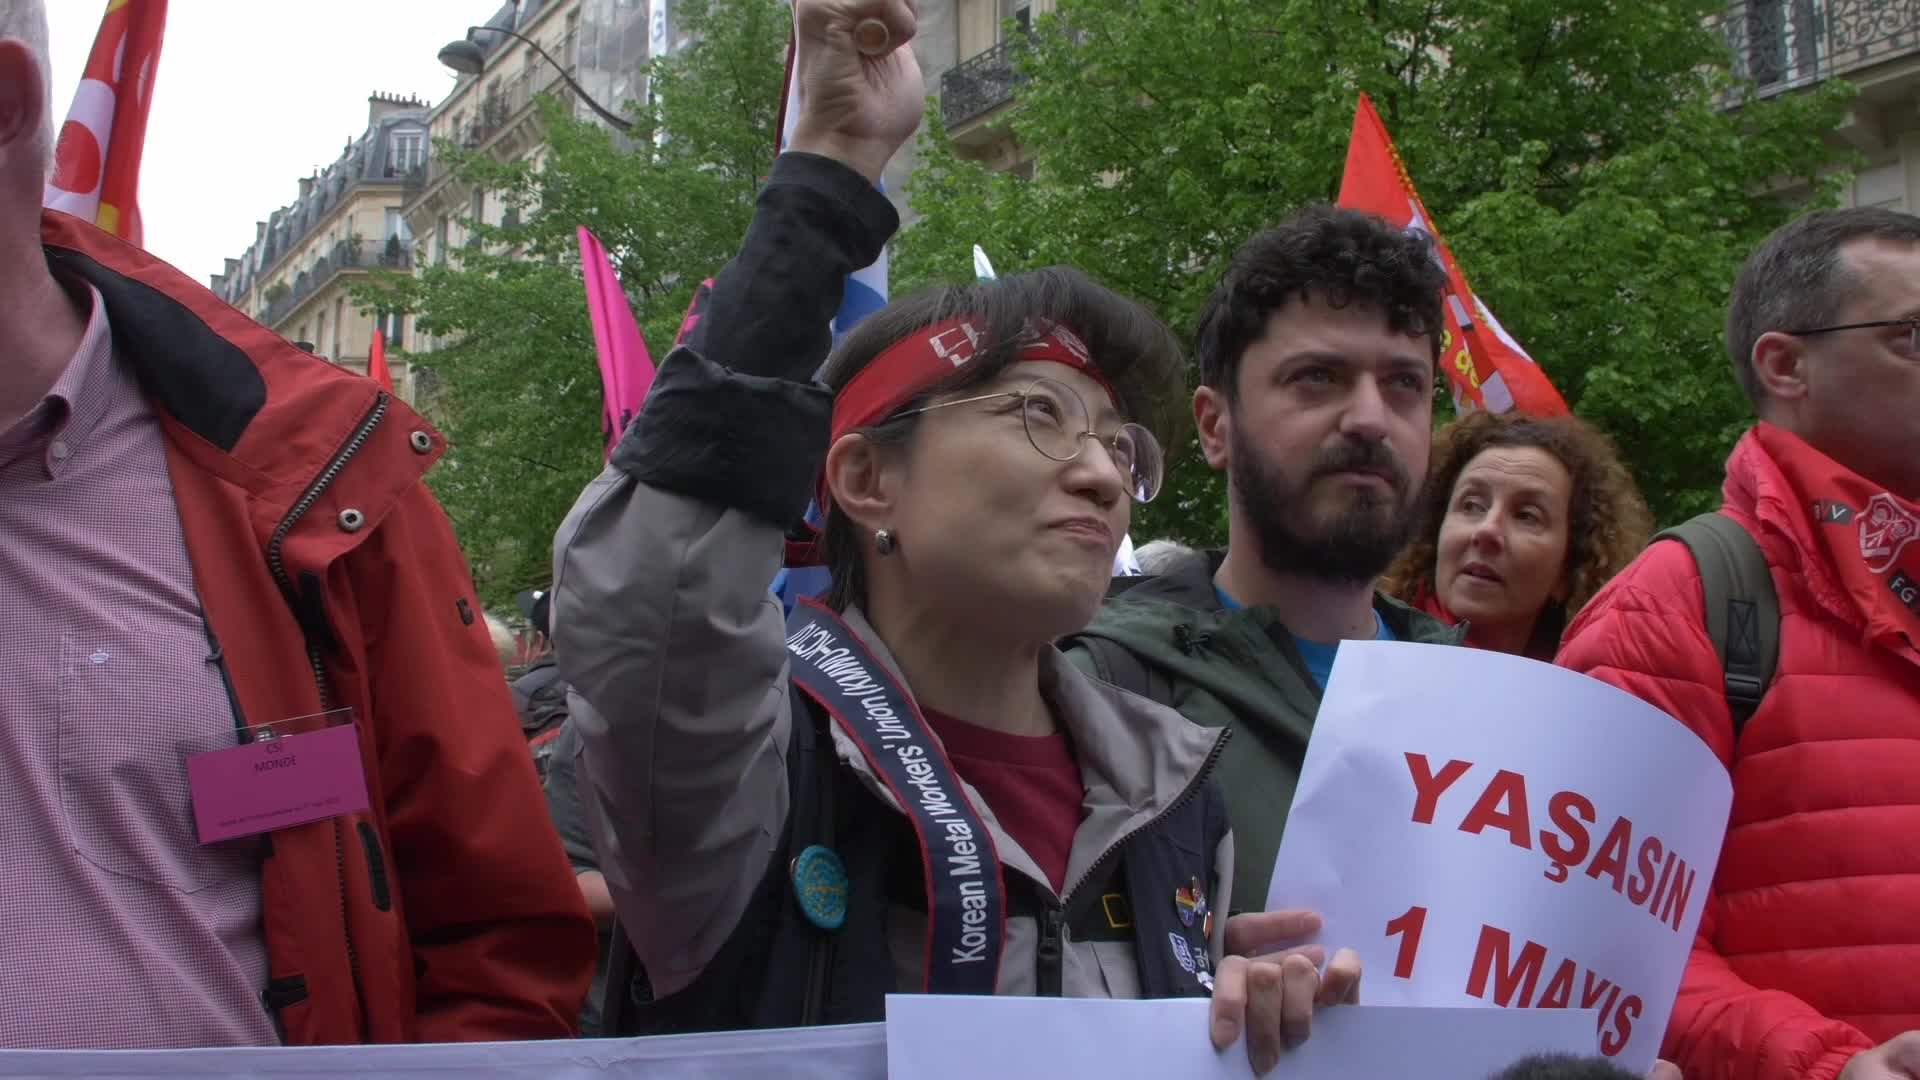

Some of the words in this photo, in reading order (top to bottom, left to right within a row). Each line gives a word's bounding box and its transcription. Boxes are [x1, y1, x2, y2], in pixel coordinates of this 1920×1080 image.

[861, 695, 912, 740] Union
[253, 756, 298, 773] MONDE
[934, 818, 981, 876] Metal
[1403, 751, 1697, 933] YAŞASIN
[951, 881, 988, 964] Korean
[1384, 905, 1428, 980] 1
